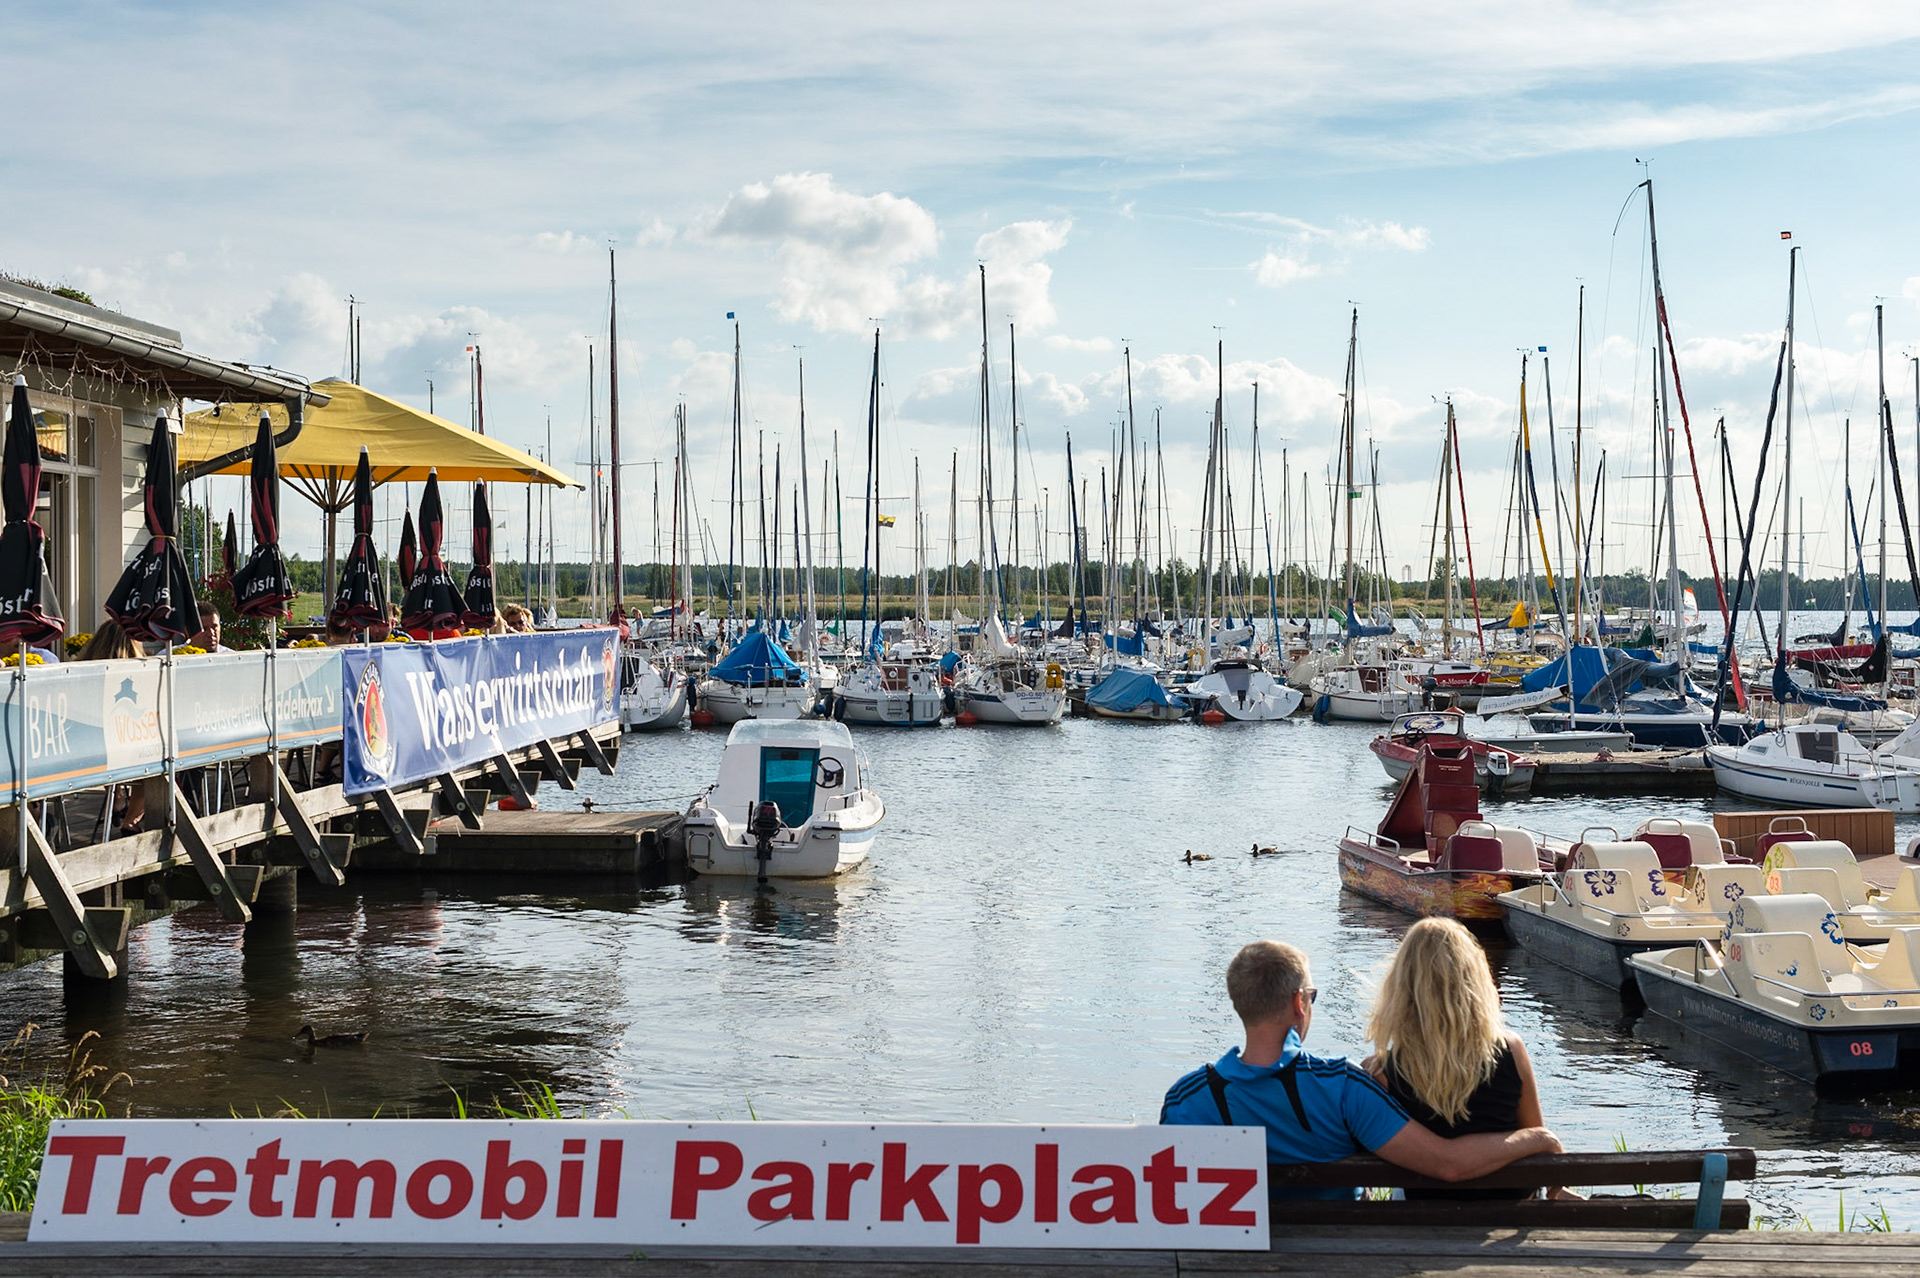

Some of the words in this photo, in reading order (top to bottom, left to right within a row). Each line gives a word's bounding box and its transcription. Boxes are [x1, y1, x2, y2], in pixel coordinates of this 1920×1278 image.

[405, 645, 596, 750] Wasserwirtschaft
[29, 692, 71, 760] BAR
[1565, 875, 1573, 891] 02
[1769, 875, 1780, 892] 03
[1730, 943, 1742, 962] 08
[1682, 994, 1800, 1052] www.hofmann-fussboden.de
[1850, 1041, 1874, 1056] 08
[48, 1135, 624, 1221] Tretmobil
[670, 1140, 1259, 1245] Parkplatz
